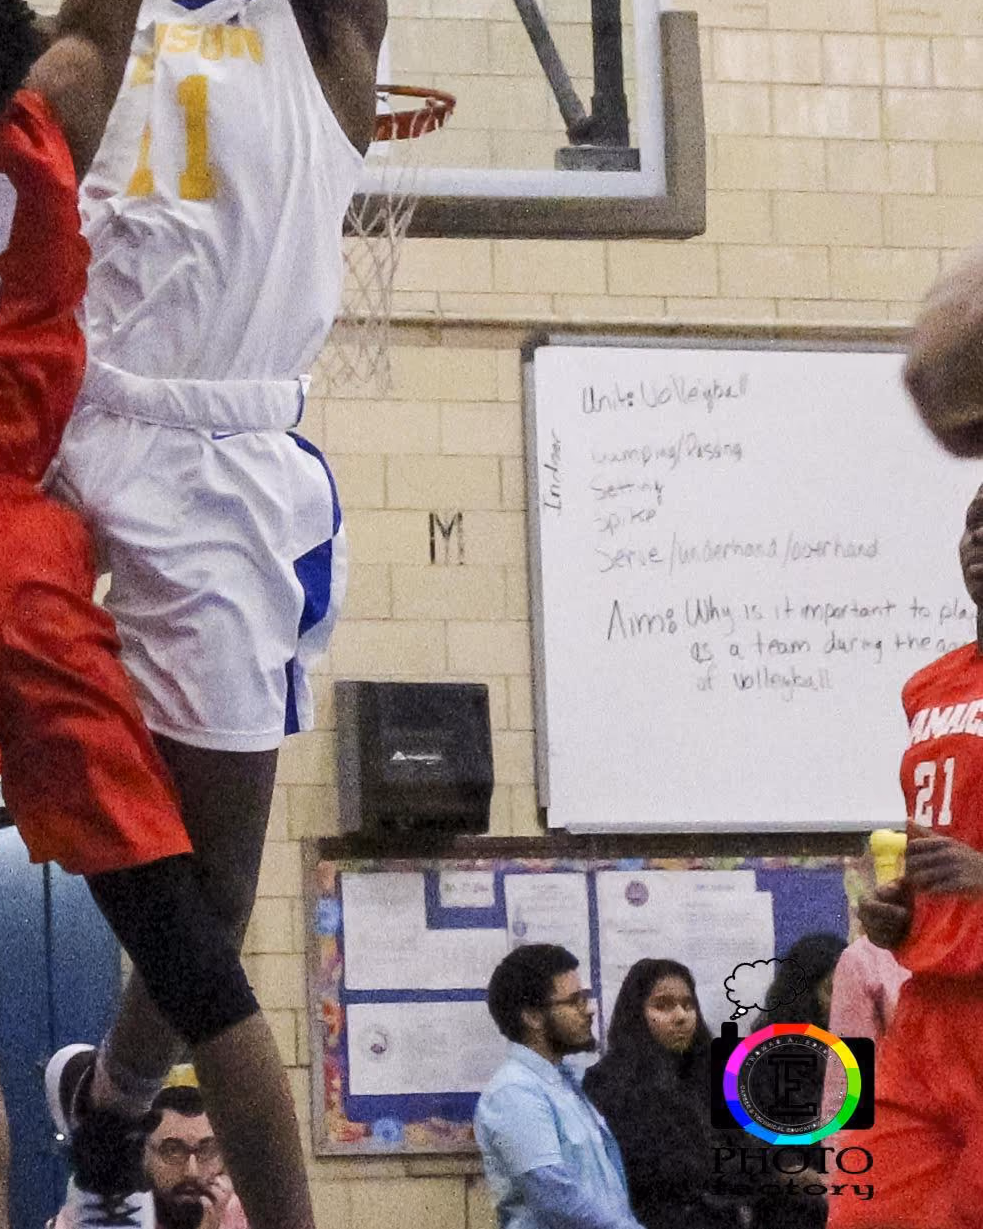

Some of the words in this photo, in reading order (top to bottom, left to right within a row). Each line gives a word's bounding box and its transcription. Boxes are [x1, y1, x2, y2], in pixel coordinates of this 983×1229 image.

[428, 512, 463, 564] M
[686, 596, 734, 636] Why
[744, 604, 763, 621] is
[775, 596, 794, 619] it
[909, 596, 930, 619] to
[937, 597, 975, 626] pla
[729, 643, 744, 657] a
[756, 632, 810, 655] team
[915, 756, 956, 827] 21
